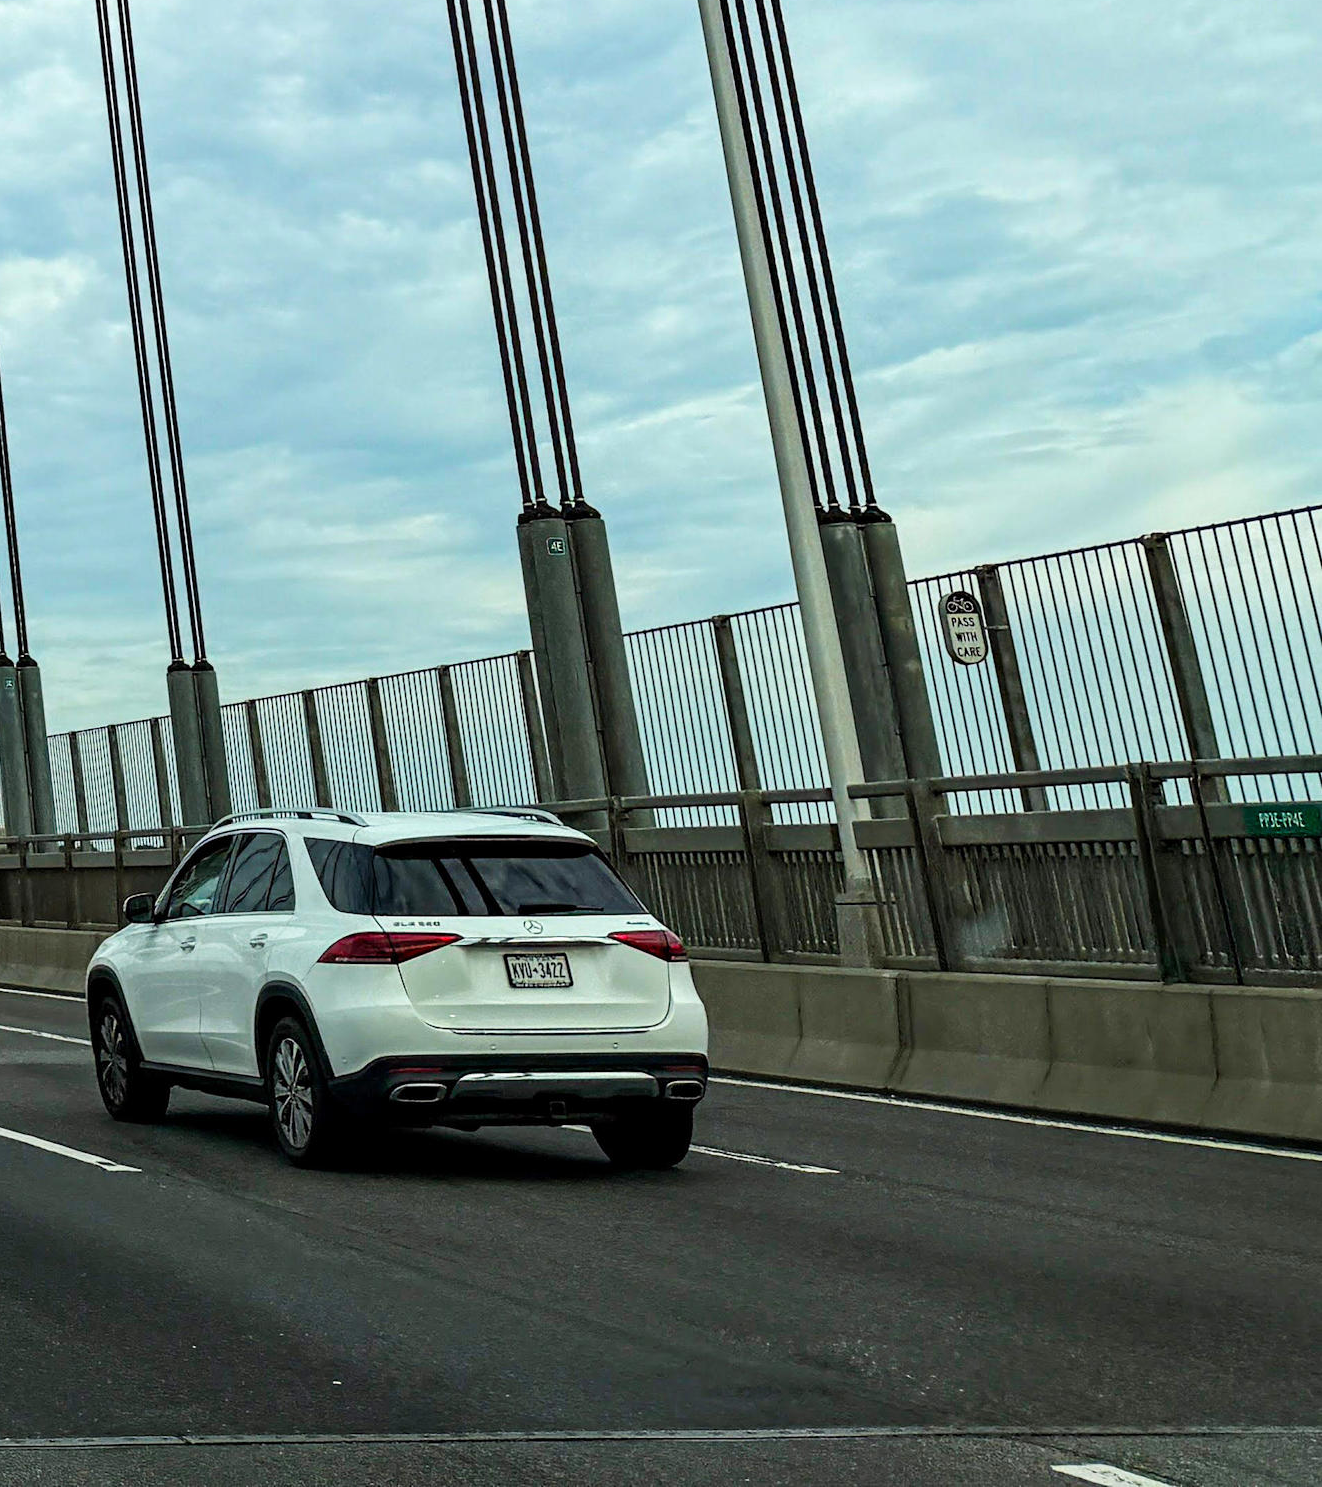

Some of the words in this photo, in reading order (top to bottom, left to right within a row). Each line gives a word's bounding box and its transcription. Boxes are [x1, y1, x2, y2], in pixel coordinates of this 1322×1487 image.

[951, 617, 975, 628] PASS
[955, 631, 978, 642] WITH
[957, 647, 982, 657] CARE
